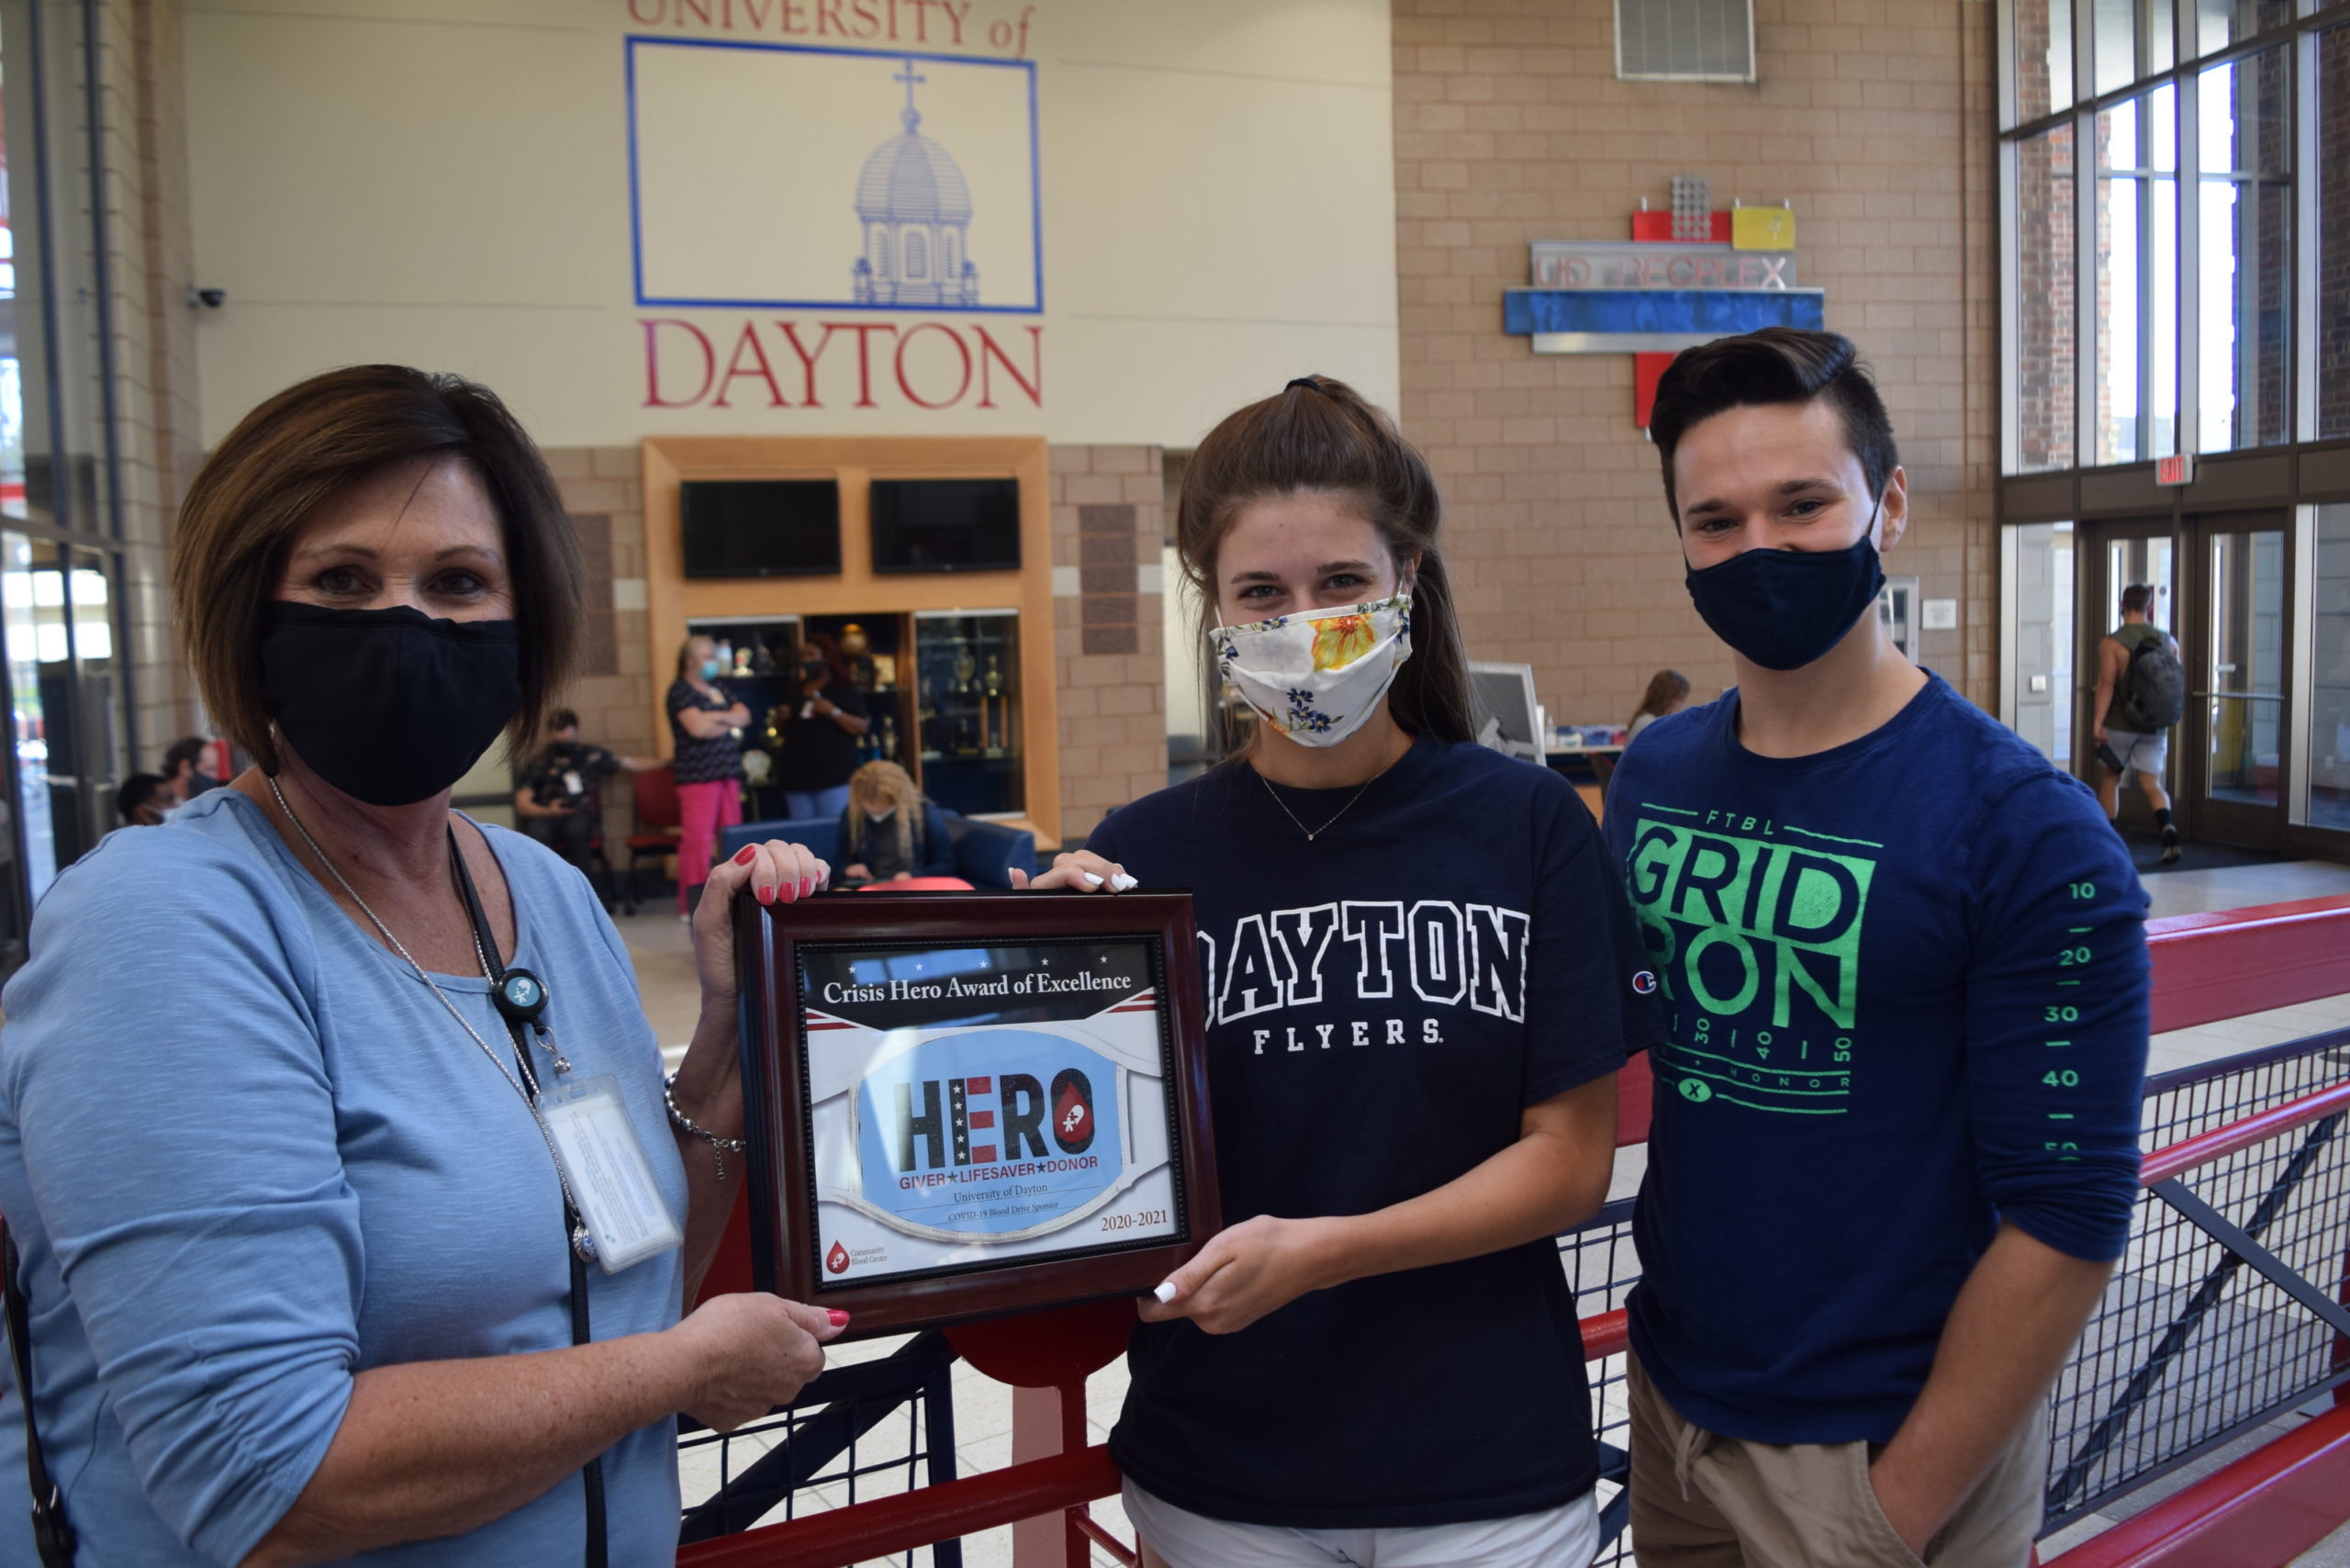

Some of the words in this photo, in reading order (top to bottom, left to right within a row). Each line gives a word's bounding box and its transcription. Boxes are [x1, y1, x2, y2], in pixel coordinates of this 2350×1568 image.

[627, 0, 970, 45] UNIVERSITY
[989, 4, 1035, 61] of
[1534, 257, 1592, 287] UD
[1618, 256, 1786, 290] RECPLEX
[637, 318, 1045, 409] DAYTON
[2160, 455, 2184, 484] EXIT
[1706, 810, 1774, 835] FTBL
[1629, 825, 1861, 944] GRID
[2068, 882, 2097, 900] 10
[2059, 946, 2091, 966] 20
[1637, 918, 1856, 1030] RON
[823, 981, 885, 1004] Crisis
[889, 979, 942, 1001] Hero
[946, 975, 1009, 998] Award
[1013, 973, 1034, 995] of
[1037, 970, 1132, 993] Excellence
[2044, 1006, 2079, 1023] 30
[1694, 1017, 1710, 1045] 30
[1756, 1031, 1773, 1059] 40
[1833, 1036, 1852, 1062] 50
[1729, 1067, 1851, 1088] HONOR
[2042, 1070, 2079, 1087] 40
[894, 1067, 1096, 1172] HERO
[900, 1172, 946, 1190] GIVER
[960, 1162, 1035, 1183] LIFESAVER
[1046, 1156, 1099, 1172] DONOR
[954, 1188, 1001, 1204] University
[1002, 1185, 1014, 1197] of
[1015, 1183, 1047, 1197] Dayton
[948, 1207, 988, 1222] COVID-19
[989, 1206, 1011, 1216] Blood
[1012, 1204, 1031, 1215] Drive
[1032, 1201, 1059, 1215] Sponsor
[1102, 1209, 1168, 1231] 2020-2021
[851, 1247, 885, 1257] Community
[851, 1256, 868, 1265] Blood
[869, 1255, 889, 1263] Center
